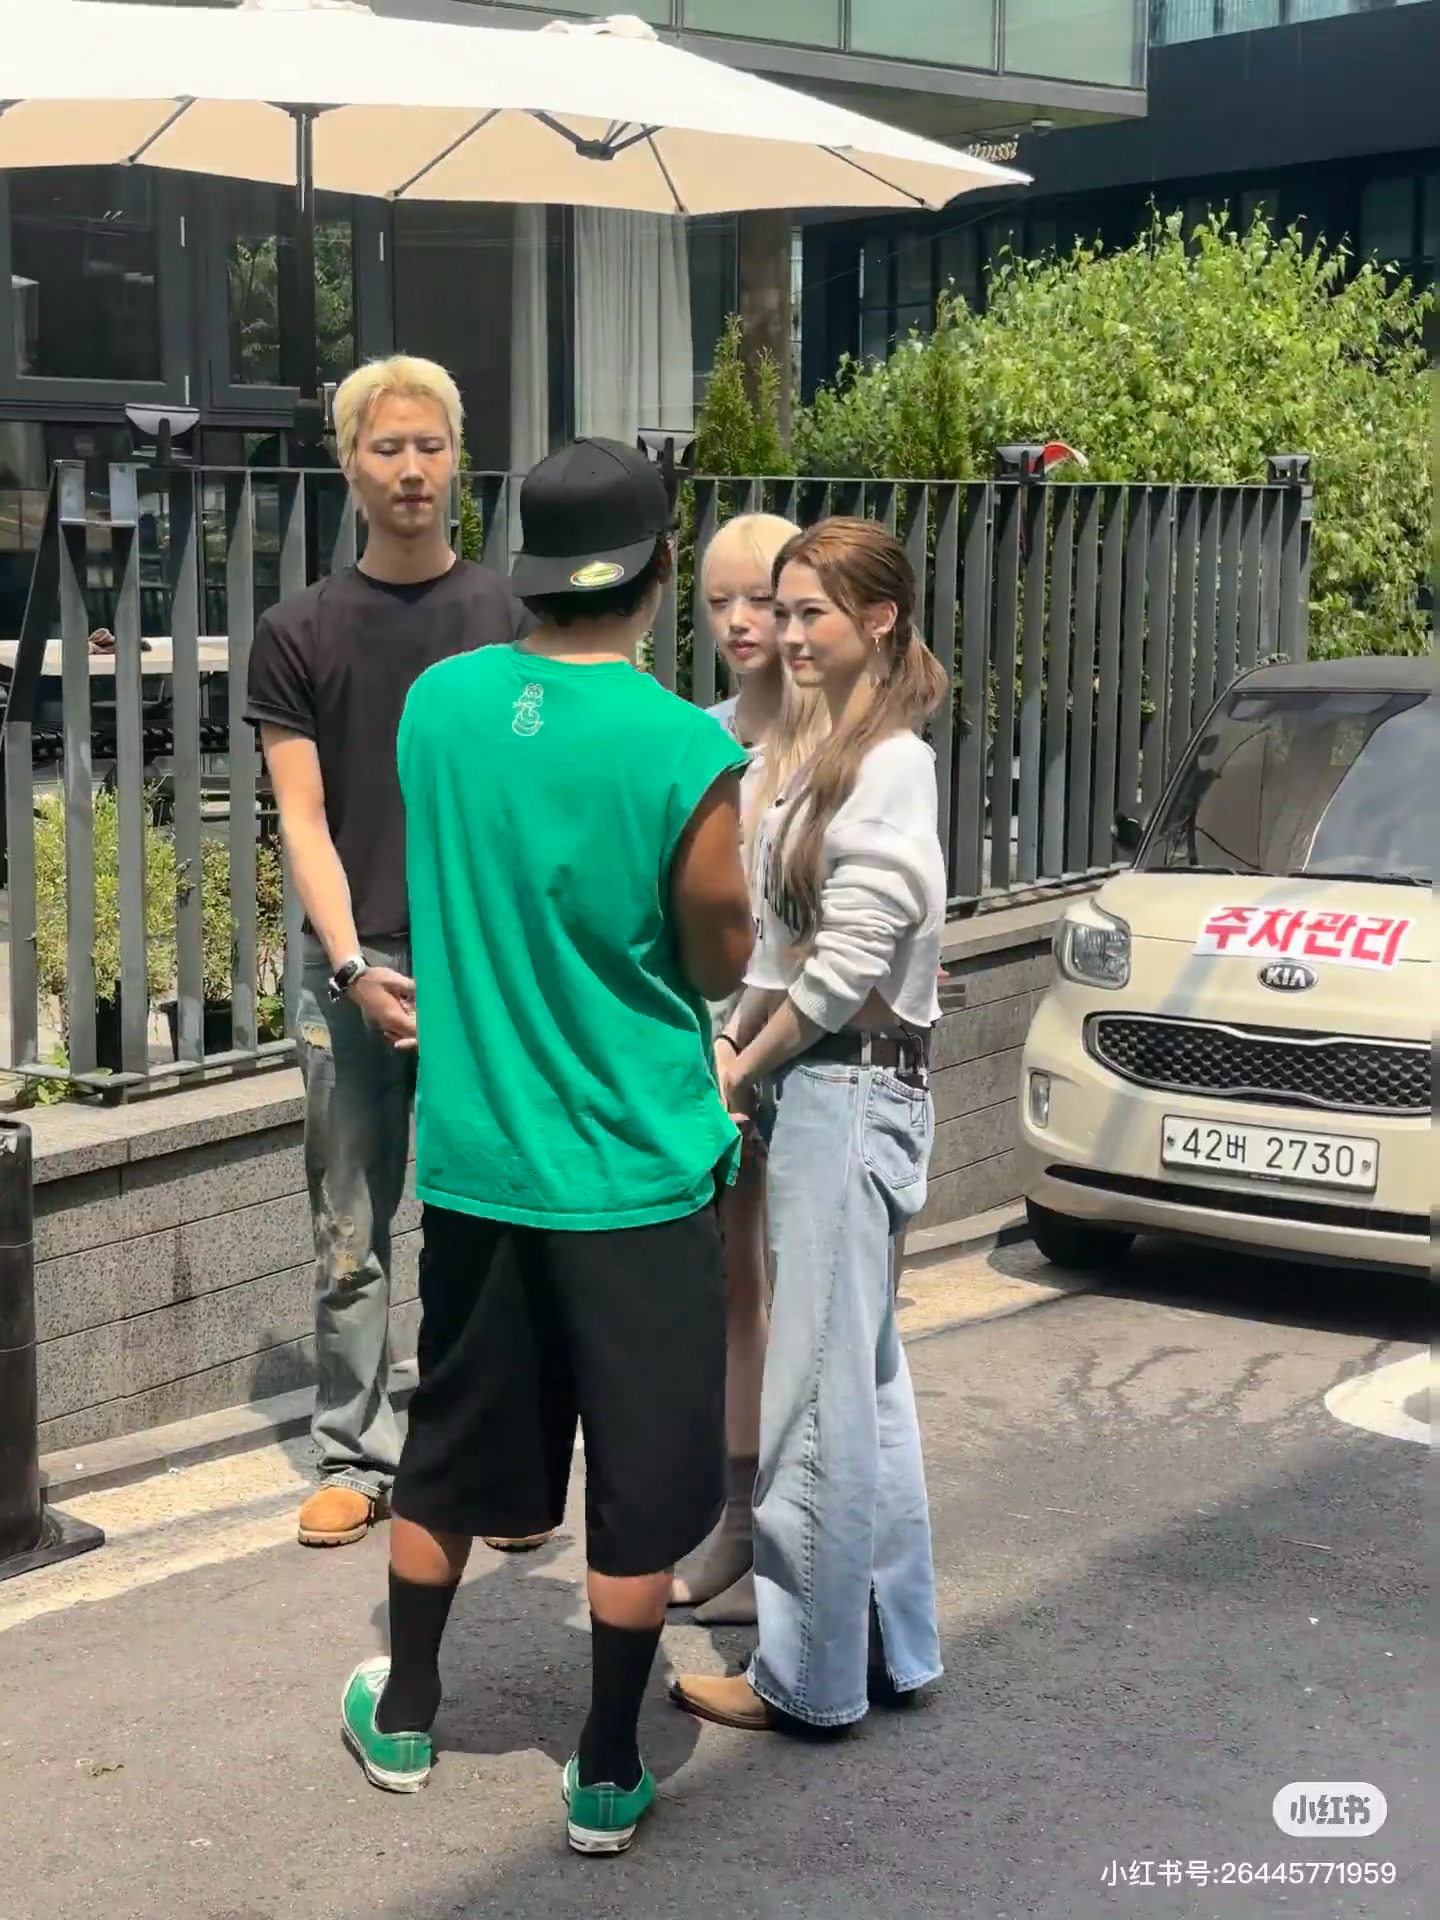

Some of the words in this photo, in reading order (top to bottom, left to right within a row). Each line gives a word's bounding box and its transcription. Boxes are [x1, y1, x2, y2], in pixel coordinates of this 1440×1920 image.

[1204, 906, 1411, 966] 주차관리
[1266, 967, 1306, 987] KIA
[1182, 1127, 1247, 1164] 42버
[1265, 1136, 1355, 1177] 2730
